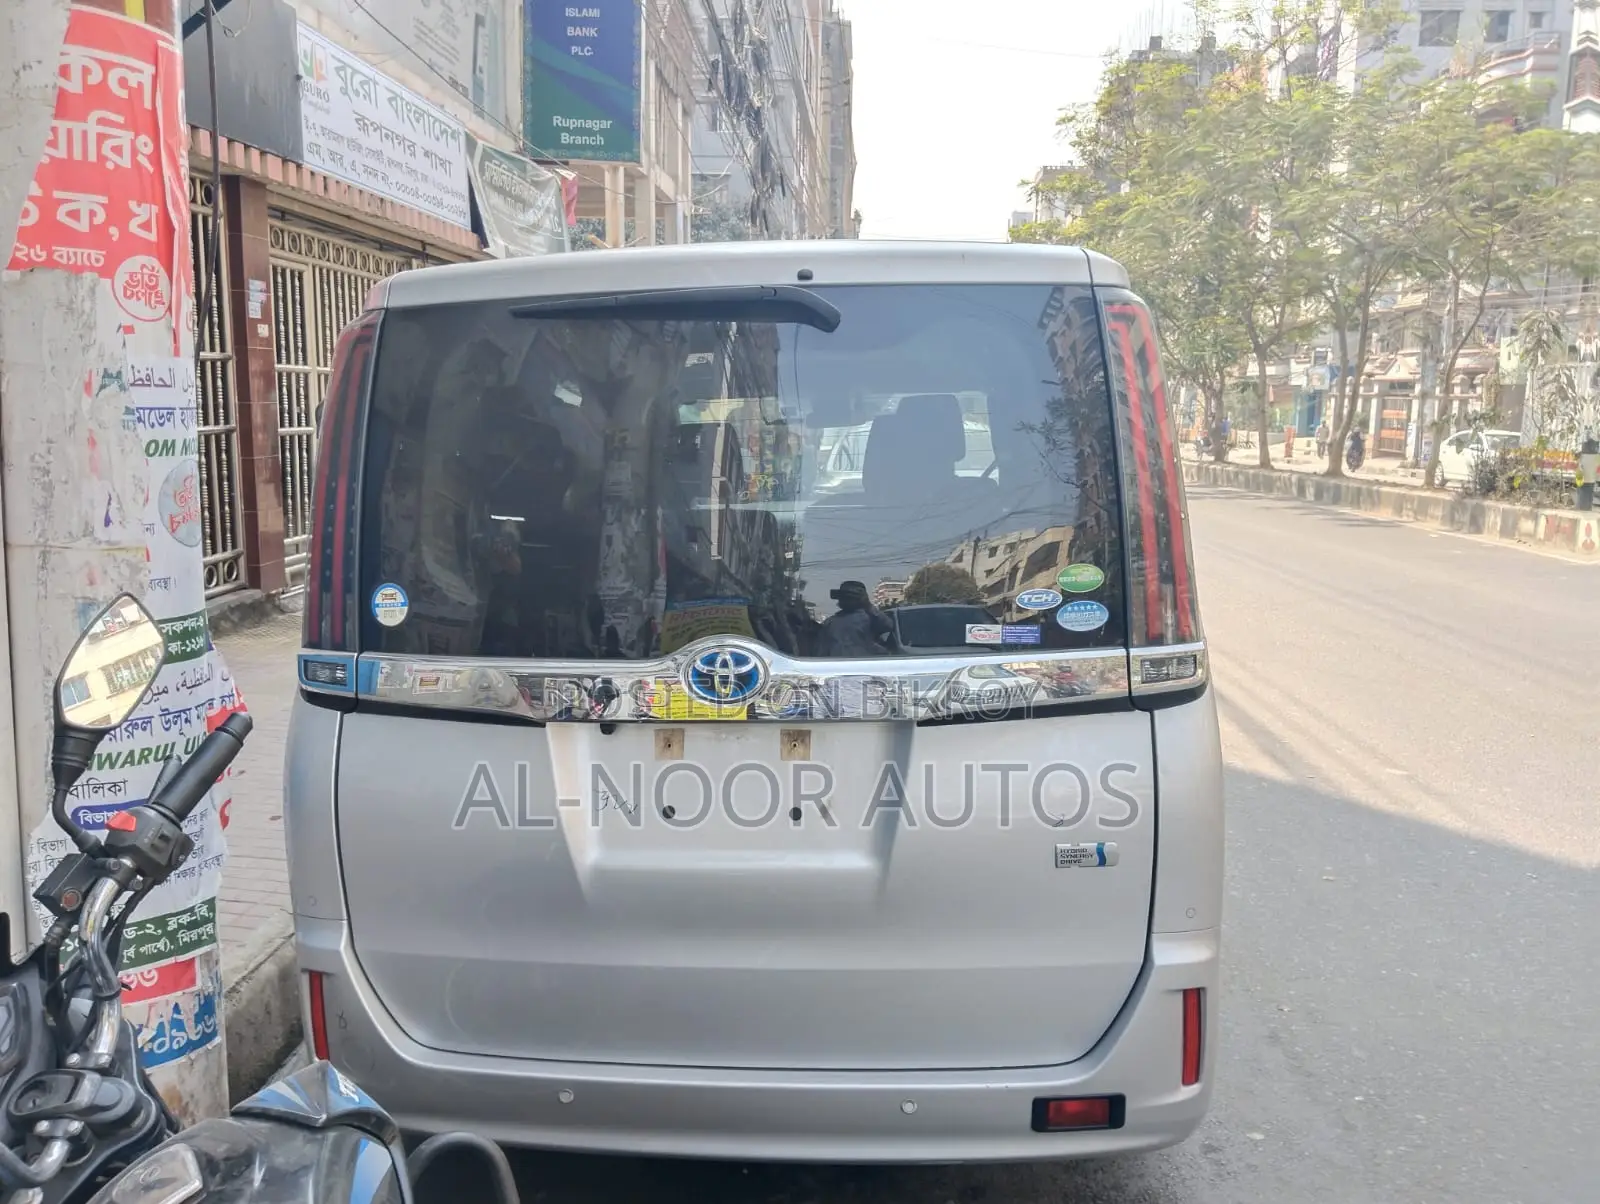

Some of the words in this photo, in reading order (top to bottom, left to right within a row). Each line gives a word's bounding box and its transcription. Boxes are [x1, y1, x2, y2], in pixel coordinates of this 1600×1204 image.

[567, 27, 598, 37] BANK
[331, 54, 380, 111] বুরো
[384, 84, 463, 153] বাংলাদেশ
[553, 116, 613, 131] Rupnagar
[353, 109, 417, 160] রূপনগর
[421, 145, 454, 178] শাখা
[560, 133, 604, 146] Branch
[135, 406, 177, 431] মডেল
[177, 922, 215, 946] মিরপুর
